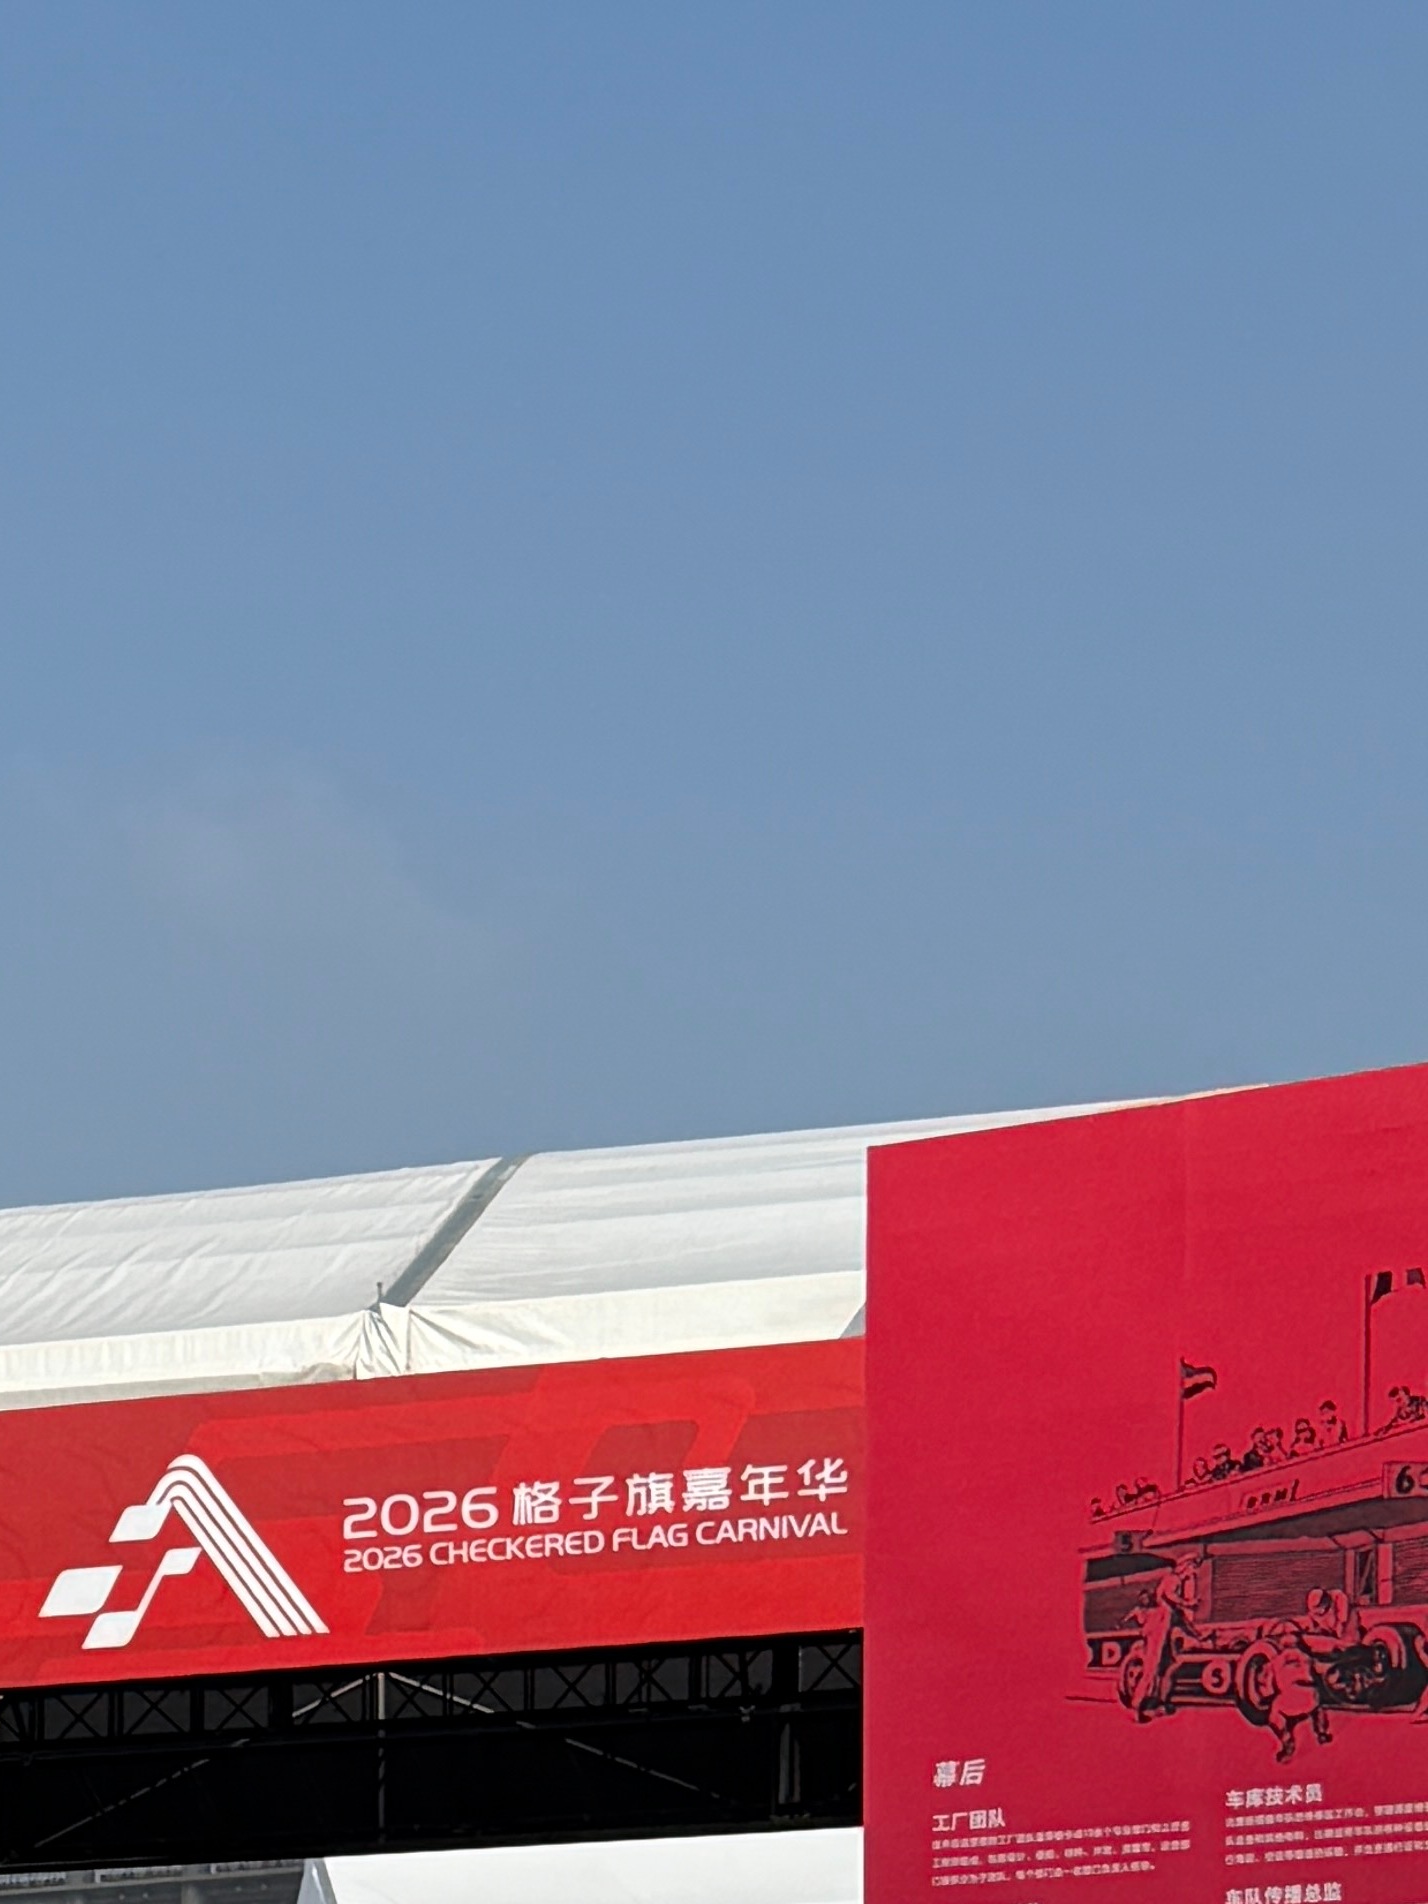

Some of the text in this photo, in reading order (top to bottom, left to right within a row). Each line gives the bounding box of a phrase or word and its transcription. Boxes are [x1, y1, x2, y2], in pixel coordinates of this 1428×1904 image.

[343, 1458, 849, 1539] 2026 格子旗嘉年华
[343, 1511, 849, 1573] 2026 CHECKERED FLAG CARNIVAL
[932, 1758, 986, 1788] 幕后
[931, 1807, 1006, 1832] 工厂团队
